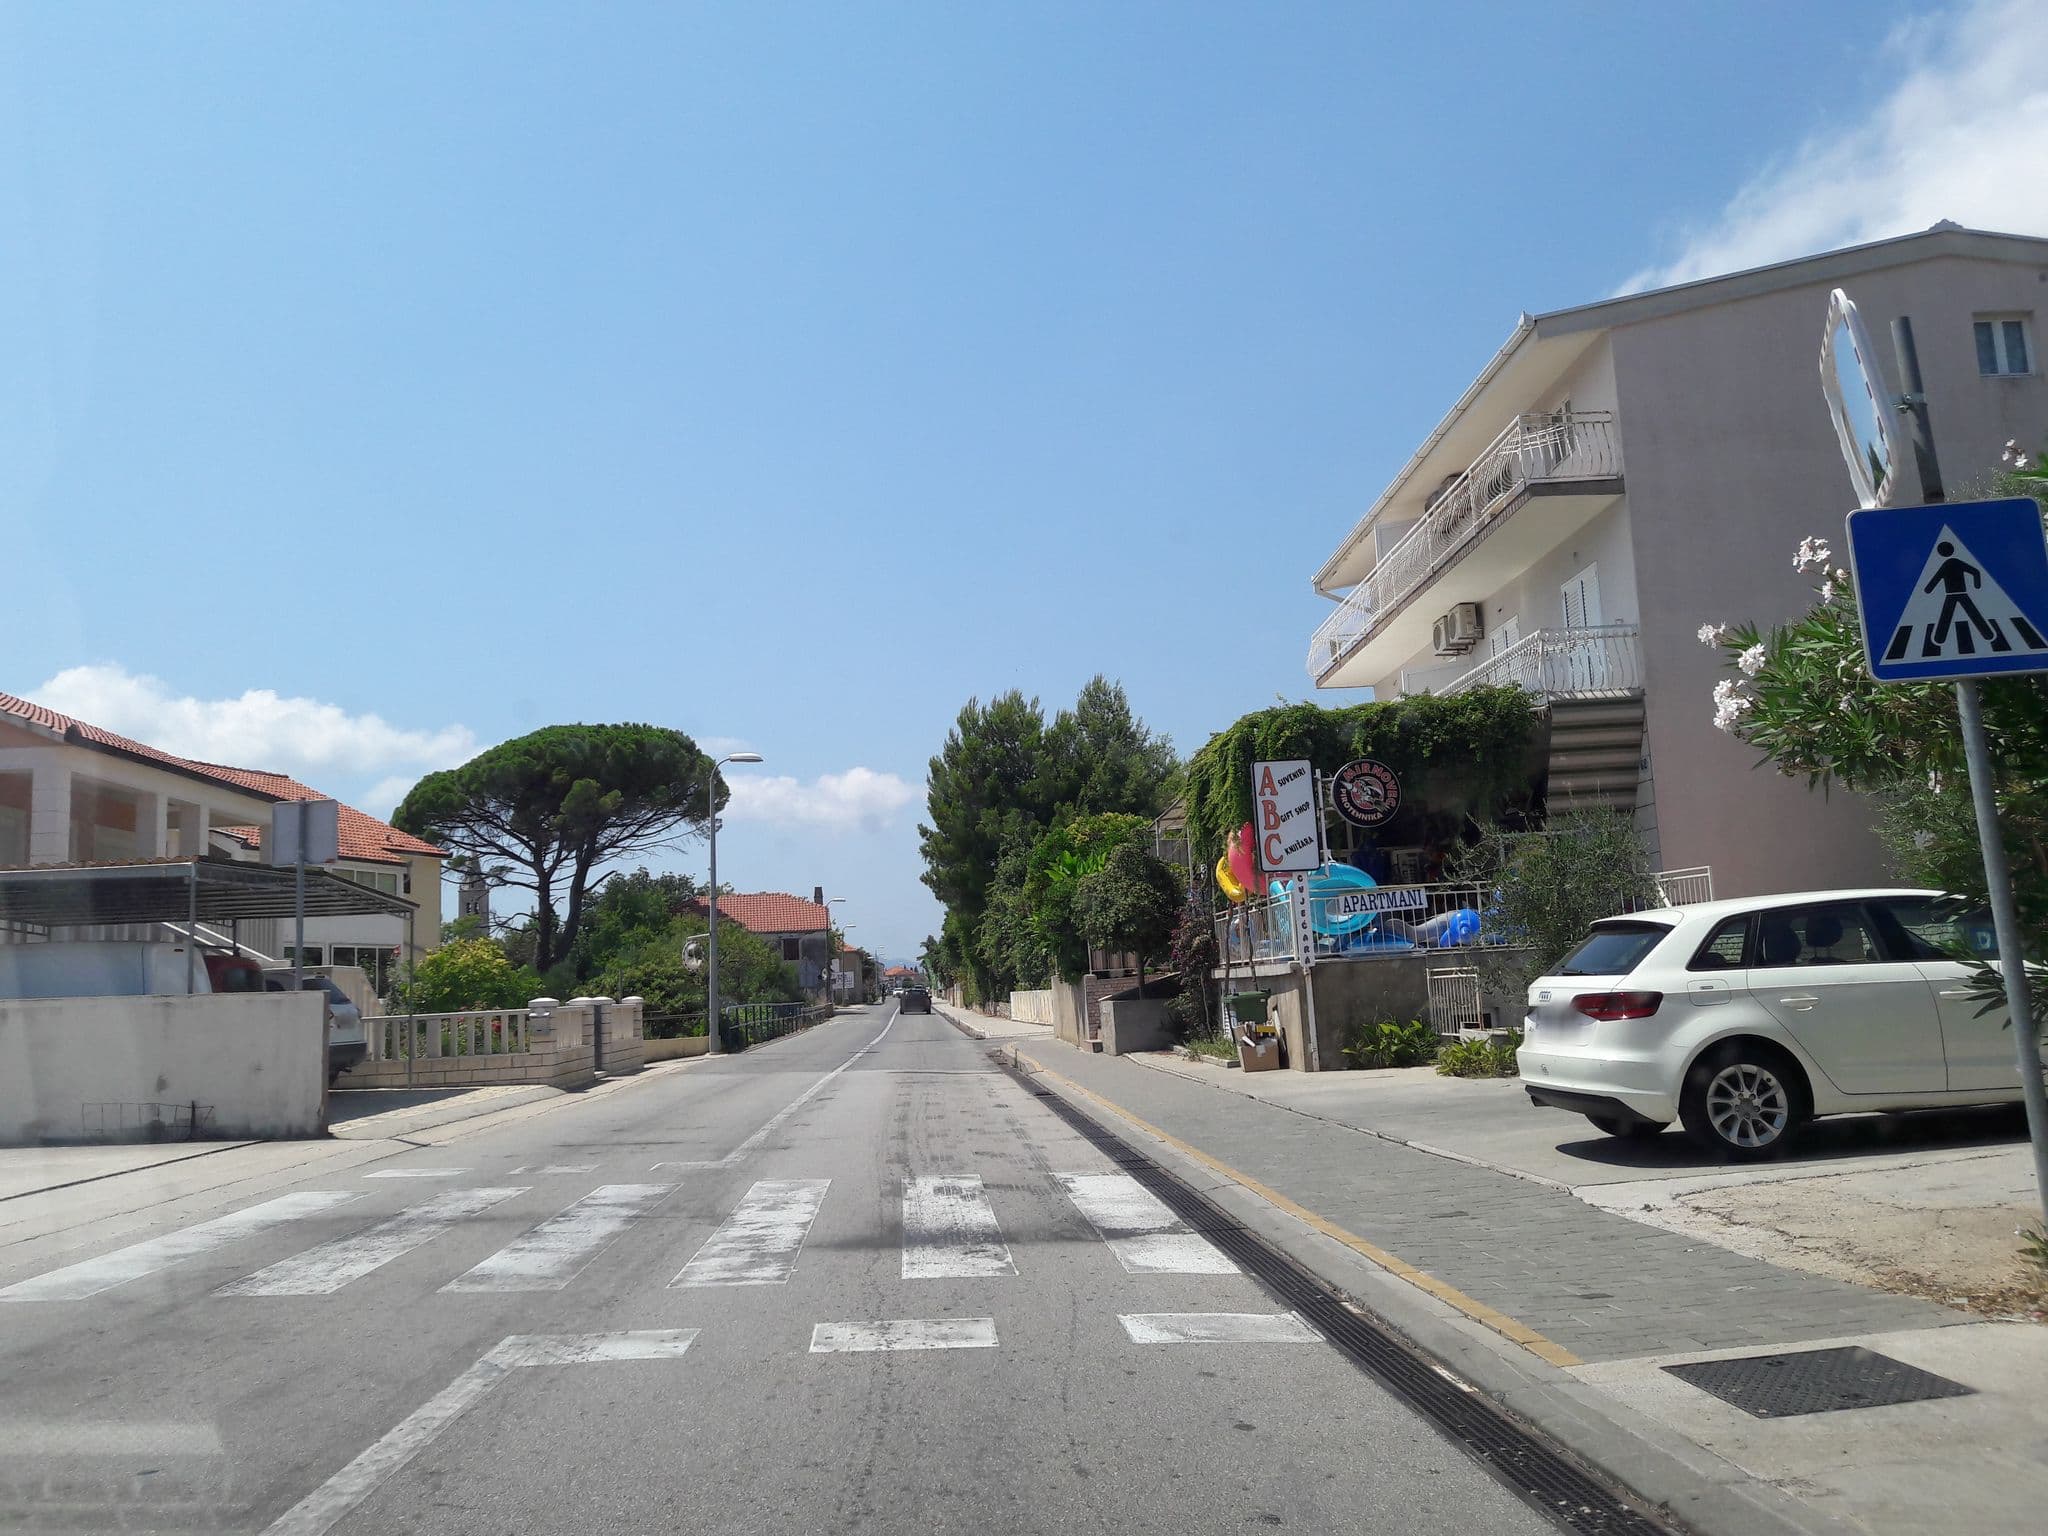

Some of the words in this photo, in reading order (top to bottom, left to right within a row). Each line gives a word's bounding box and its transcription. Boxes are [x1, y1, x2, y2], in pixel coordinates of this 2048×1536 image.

[1277, 767, 1306, 787] SUVENIRI
[1343, 762, 1398, 808] MIRNOVEC
[1280, 810, 1294, 823] GIFT
[1295, 801, 1310, 816] SHOP
[1340, 788, 1383, 821] PIROTEHNIKA
[1343, 889, 1424, 913] APARTMANI
